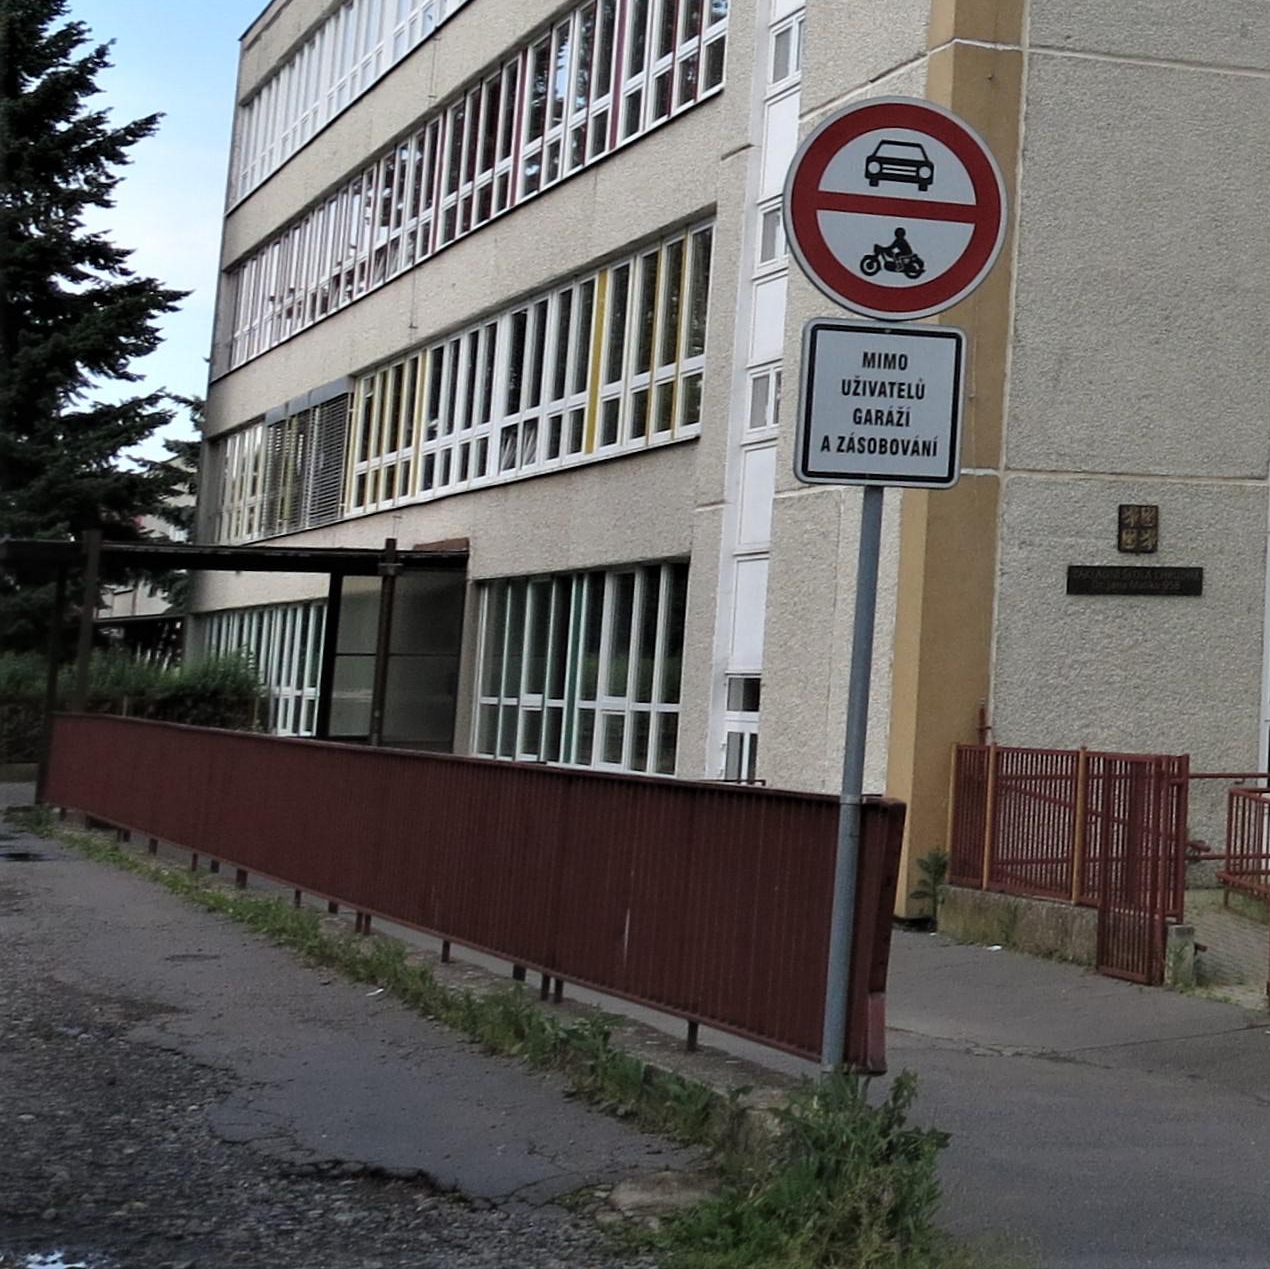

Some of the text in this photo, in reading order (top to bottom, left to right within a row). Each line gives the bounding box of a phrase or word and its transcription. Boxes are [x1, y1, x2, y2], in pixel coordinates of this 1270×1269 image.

[862, 351, 908, 371] MIMO
[841, 375, 925, 400] UŽIVATELŮ
[853, 405, 911, 427] GARÁŽÍ
[820, 432, 938, 457] A ZÁSOBOVÁNÍ
